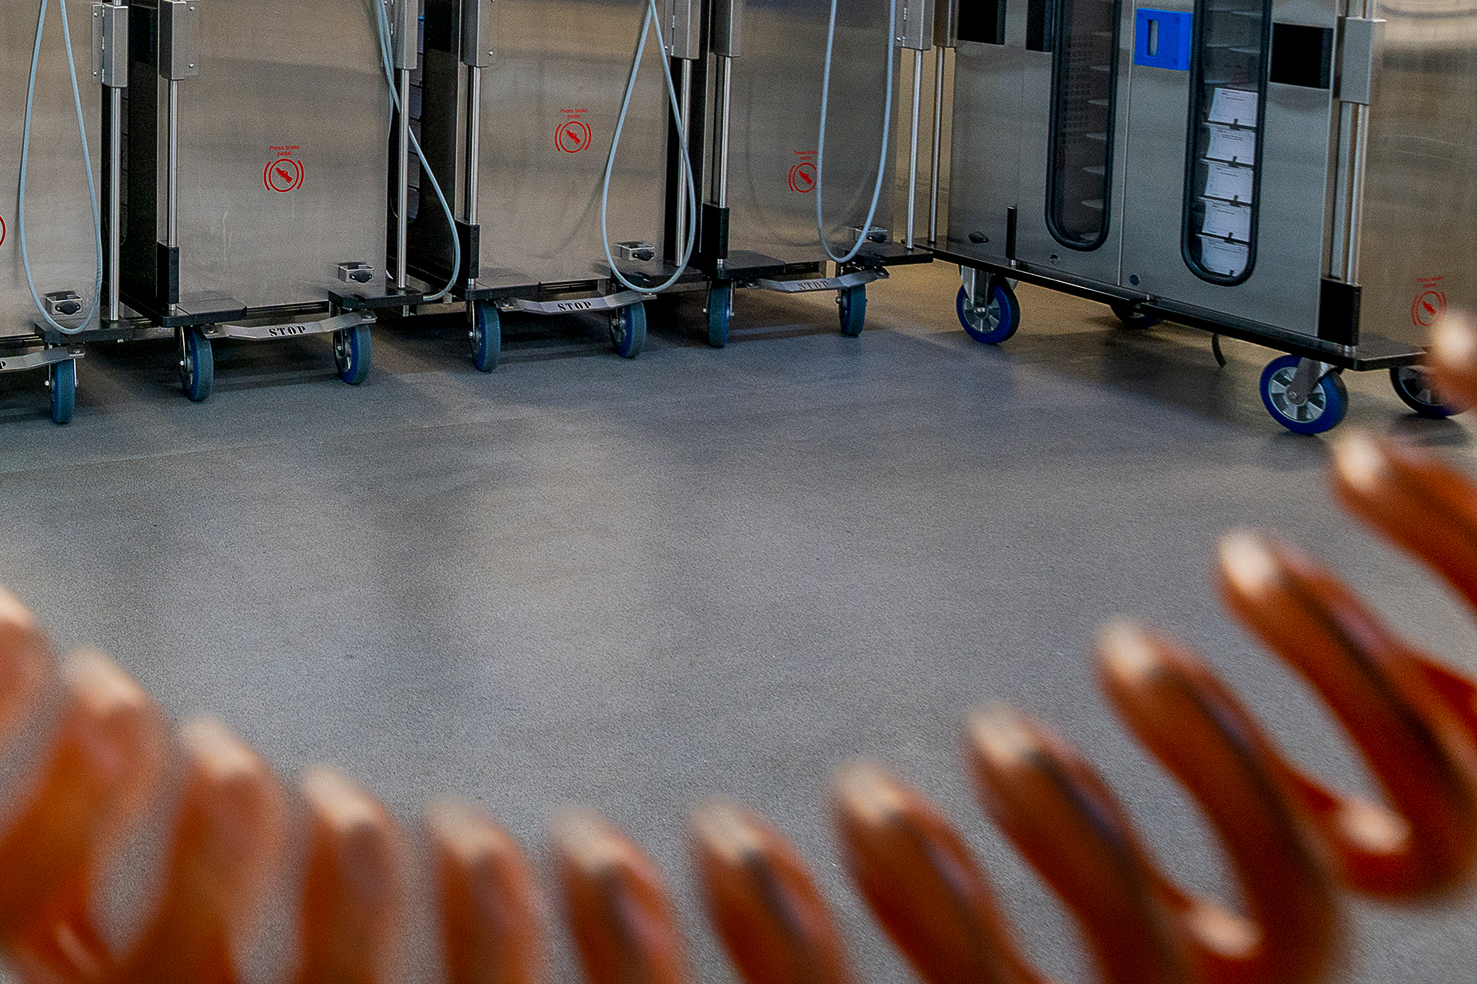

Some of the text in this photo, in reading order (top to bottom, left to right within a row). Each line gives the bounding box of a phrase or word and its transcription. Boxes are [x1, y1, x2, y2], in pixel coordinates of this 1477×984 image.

[796, 280, 830, 291] STOP
[557, 301, 592, 312] STOP
[268, 325, 307, 337] STOP
